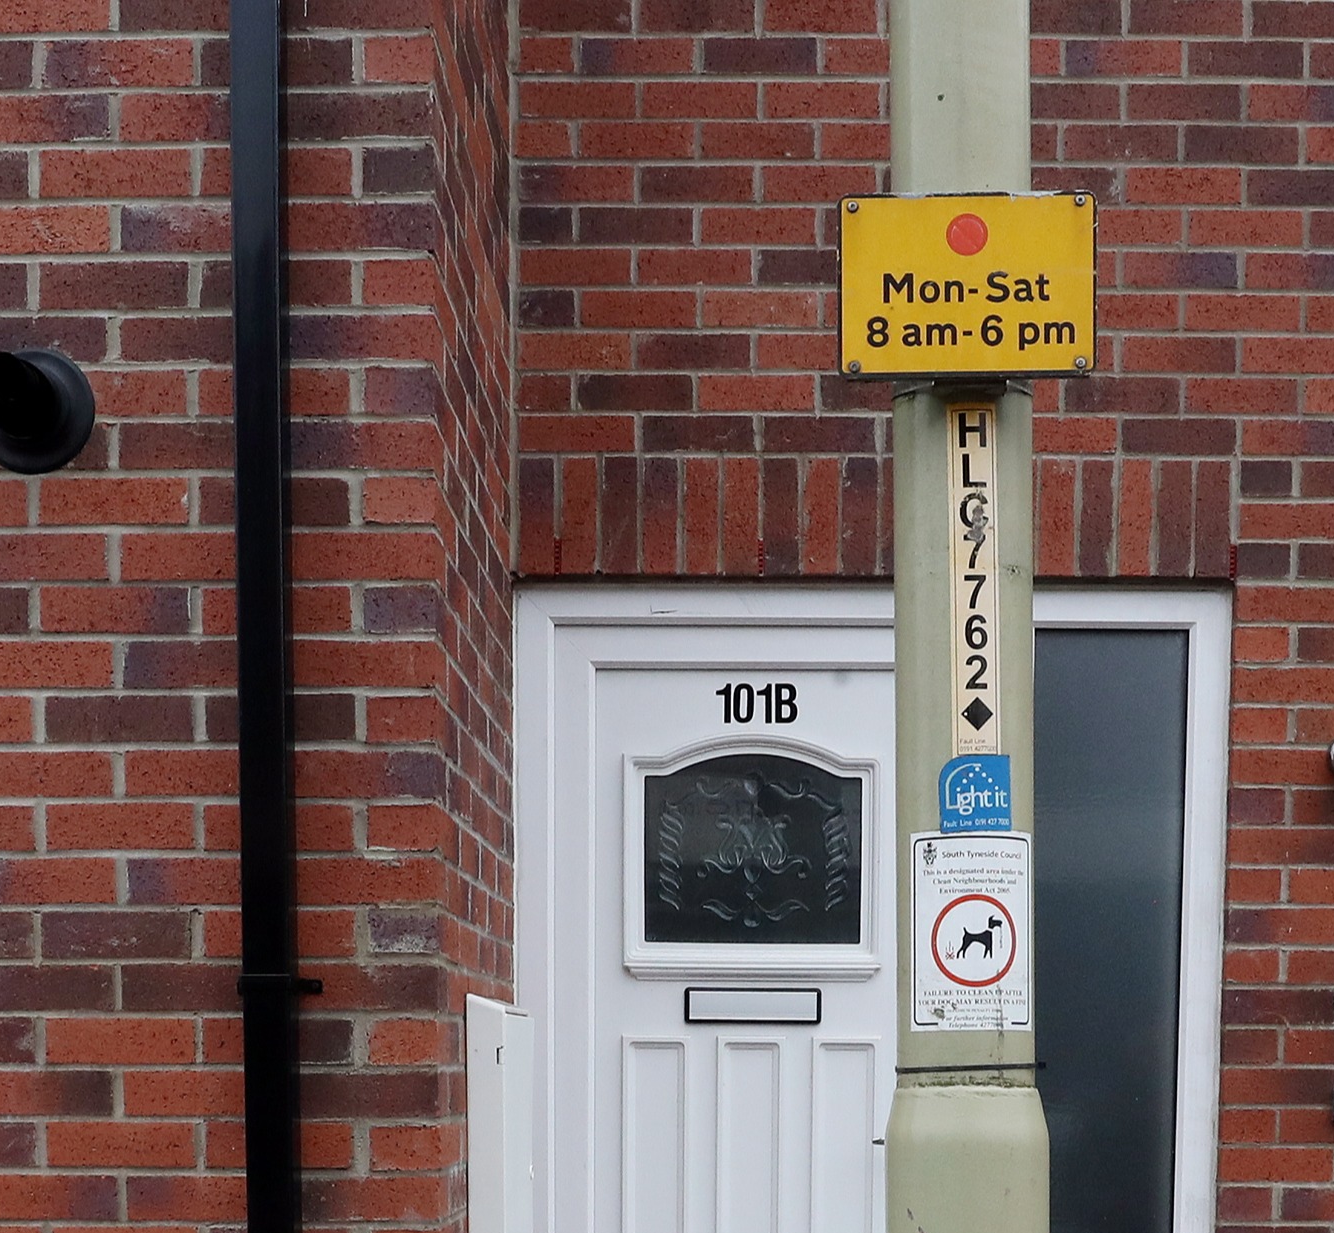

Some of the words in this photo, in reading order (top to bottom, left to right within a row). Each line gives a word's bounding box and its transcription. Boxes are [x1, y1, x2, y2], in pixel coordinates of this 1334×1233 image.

[715, 683, 798, 724] 101B
[943, 820, 958, 828] Fault
[959, 819, 973, 827] Line
[974, 818, 987, 826] 0191
[942, 850, 965, 859] South
[967, 850, 998, 859] Tyneside
[1000, 850, 1022, 859] Council
[953, 877, 1006, 885] Neighbourhoods
